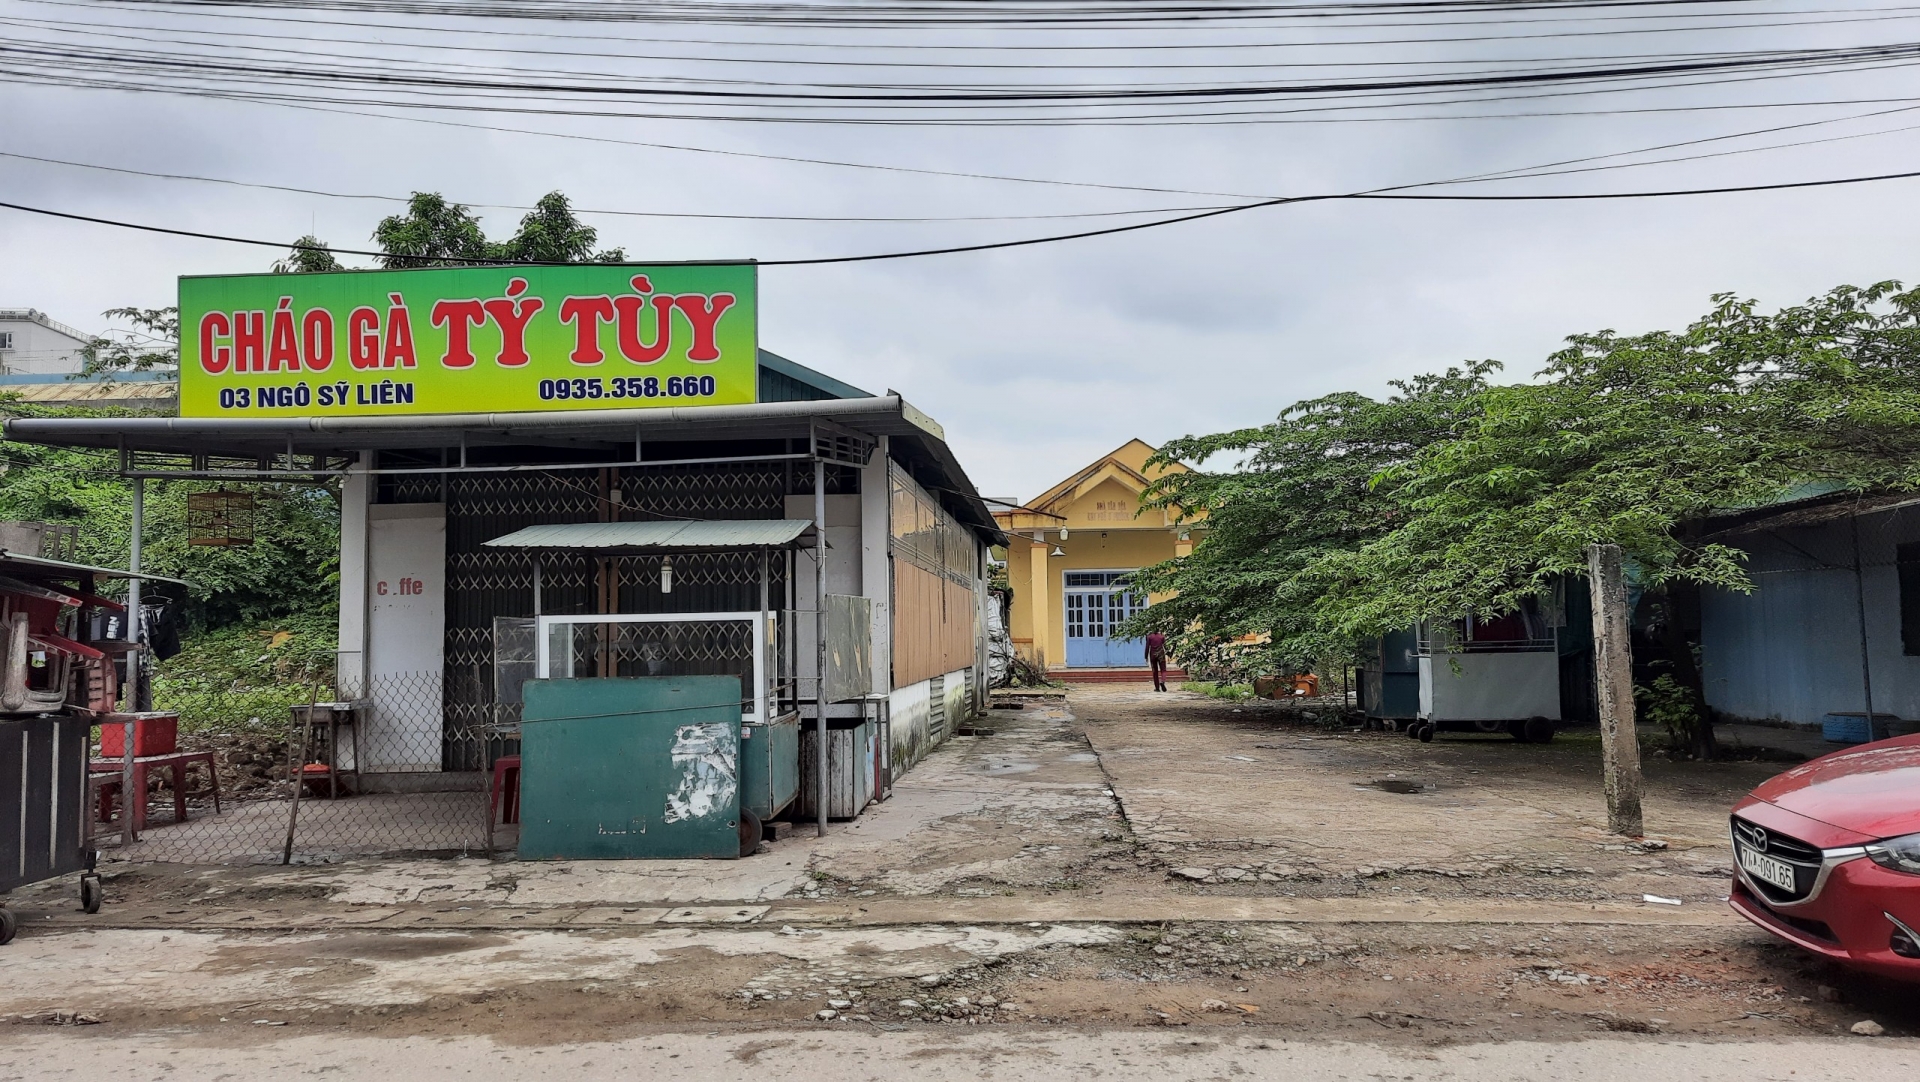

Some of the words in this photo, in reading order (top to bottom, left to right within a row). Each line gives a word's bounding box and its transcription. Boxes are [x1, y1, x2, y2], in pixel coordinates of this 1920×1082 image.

[200, 297, 334, 375] CHÁO
[349, 292, 417, 371] GÀ
[432, 277, 543, 368] TÝ
[560, 275, 735, 365] TÙY
[220, 388, 250, 408] 03
[258, 382, 310, 407] NGÔ
[318, 381, 350, 406] SỸ
[357, 380, 414, 405] LIÊN
[540, 376, 715, 400] 0935.358.660
[377, 577, 423, 596] cffe
